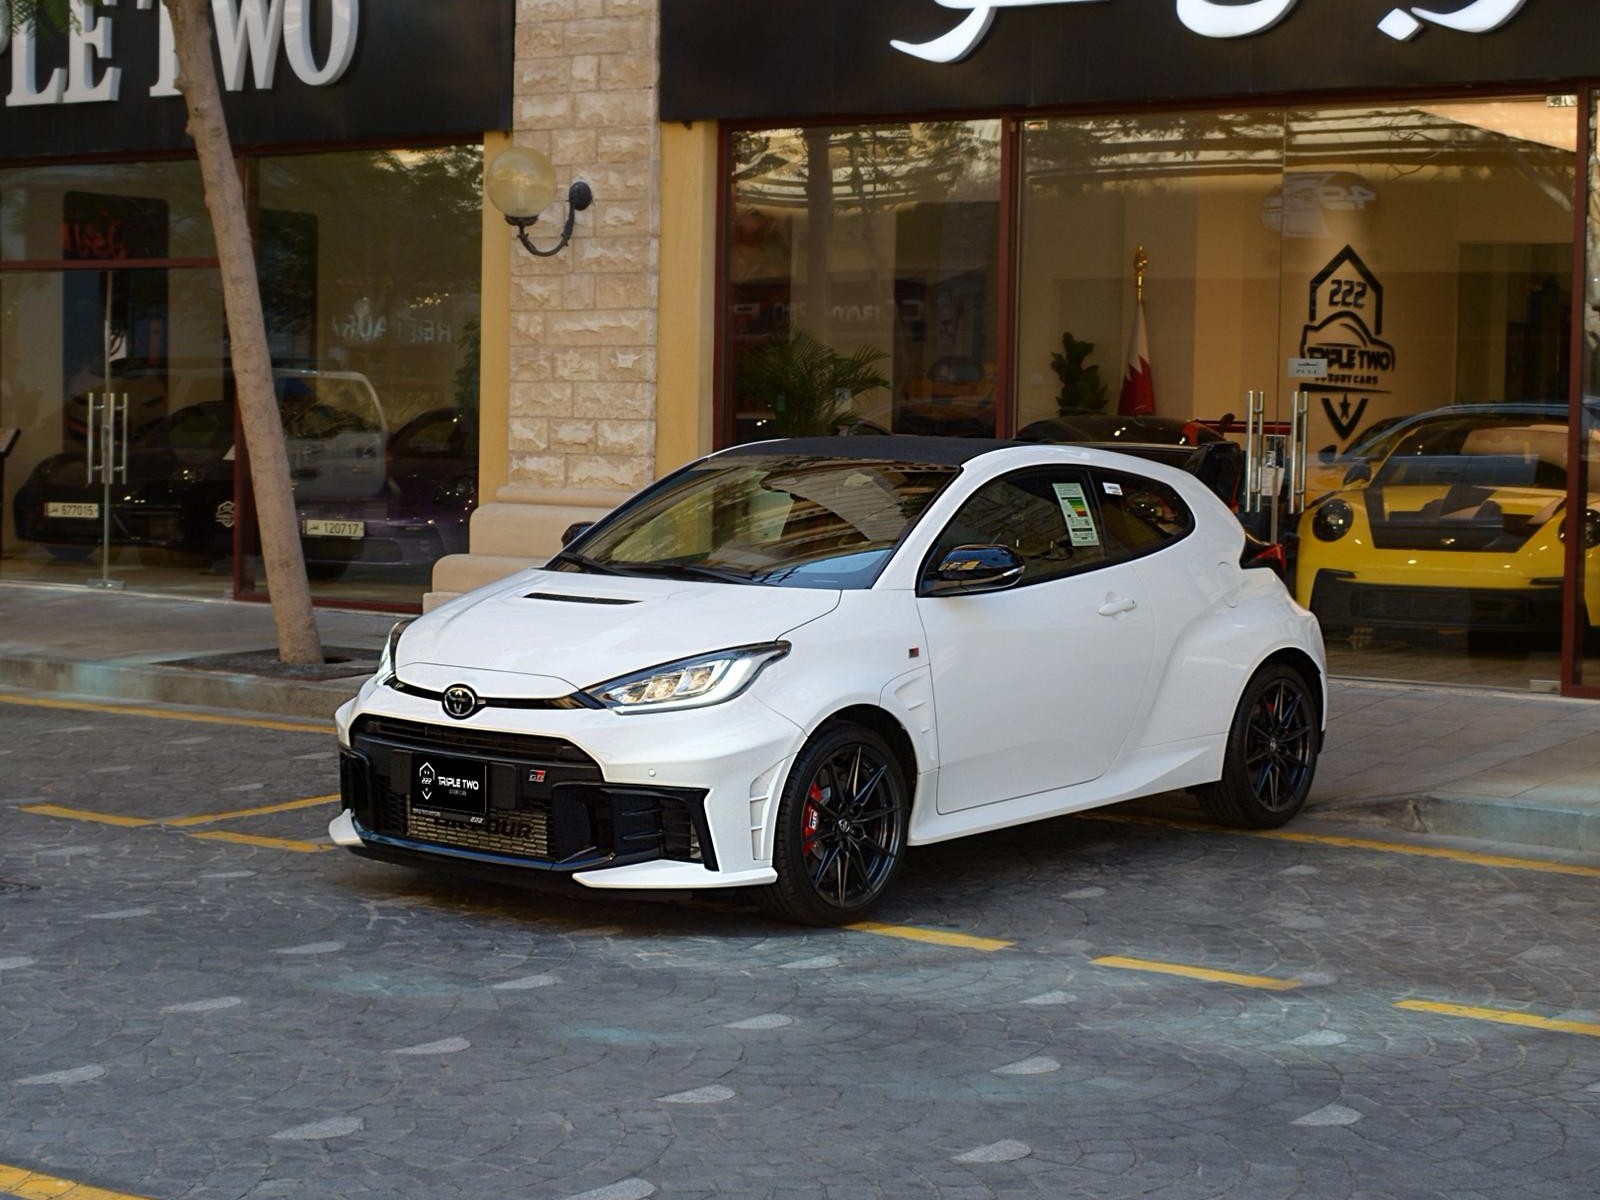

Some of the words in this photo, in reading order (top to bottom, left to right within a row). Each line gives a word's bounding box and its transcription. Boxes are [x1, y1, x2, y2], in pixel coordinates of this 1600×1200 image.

[0, 0, 122, 106] LE
[1329, 279, 1367, 308] 222
[1358, 350, 1390, 371] TWO
[324, 522, 360, 535] 120717
[437, 776, 461, 788] TRIPLE
[462, 779, 479, 790] TWO
